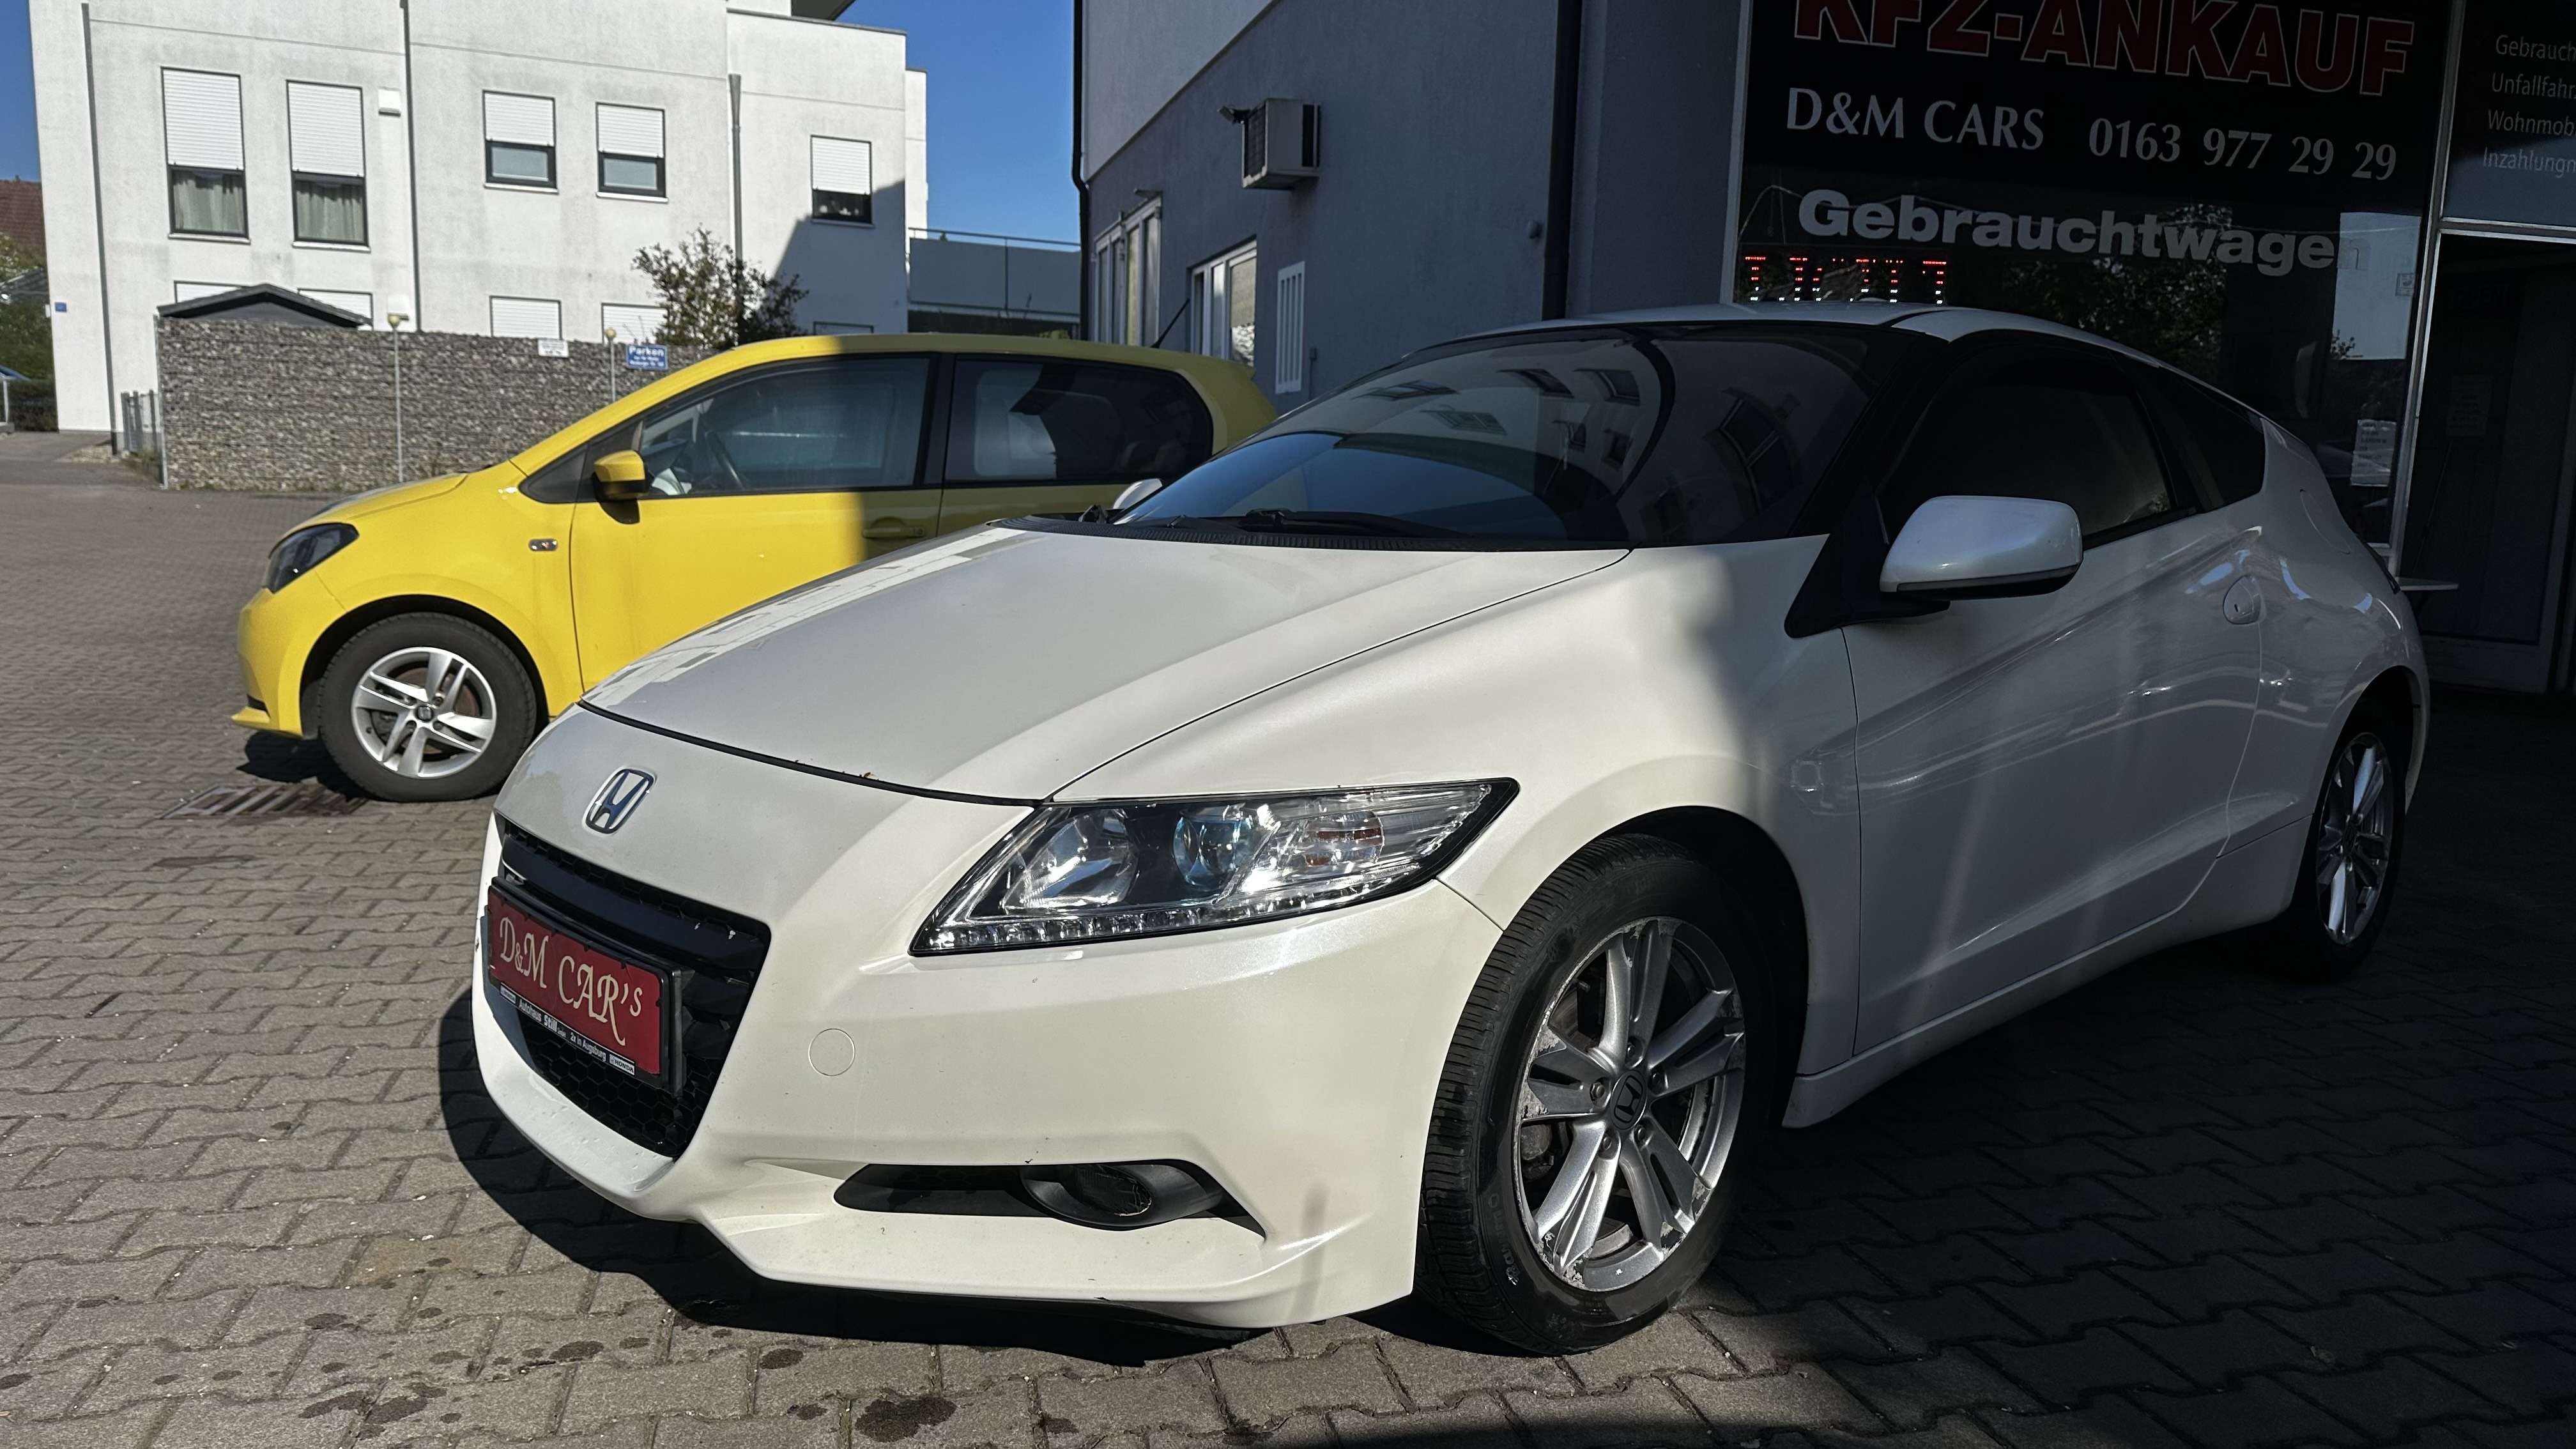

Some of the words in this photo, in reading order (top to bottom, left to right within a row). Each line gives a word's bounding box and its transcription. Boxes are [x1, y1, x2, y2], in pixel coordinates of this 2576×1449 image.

[2492, 72, 2576, 100] Unfallfahr
[1786, 87, 1905, 139] D&M
[1924, 100, 2044, 150] CARS
[2089, 117, 2182, 163] 0163
[2202, 127, 2272, 169] 977
[2288, 135, 2334, 175] 29
[2351, 141, 2397, 181] 29
[2487, 109, 2576, 137] Wohnmob
[2483, 146, 2576, 179] Inzahlungn
[629, 346, 665, 357] Parken
[499, 916, 549, 989] D&M
[518, 999, 542, 1022] Autohaus
[544, 1015, 558, 1032] Still
[582, 1039, 606, 1062] Augsburg
[614, 1059, 634, 1073] HONDA
